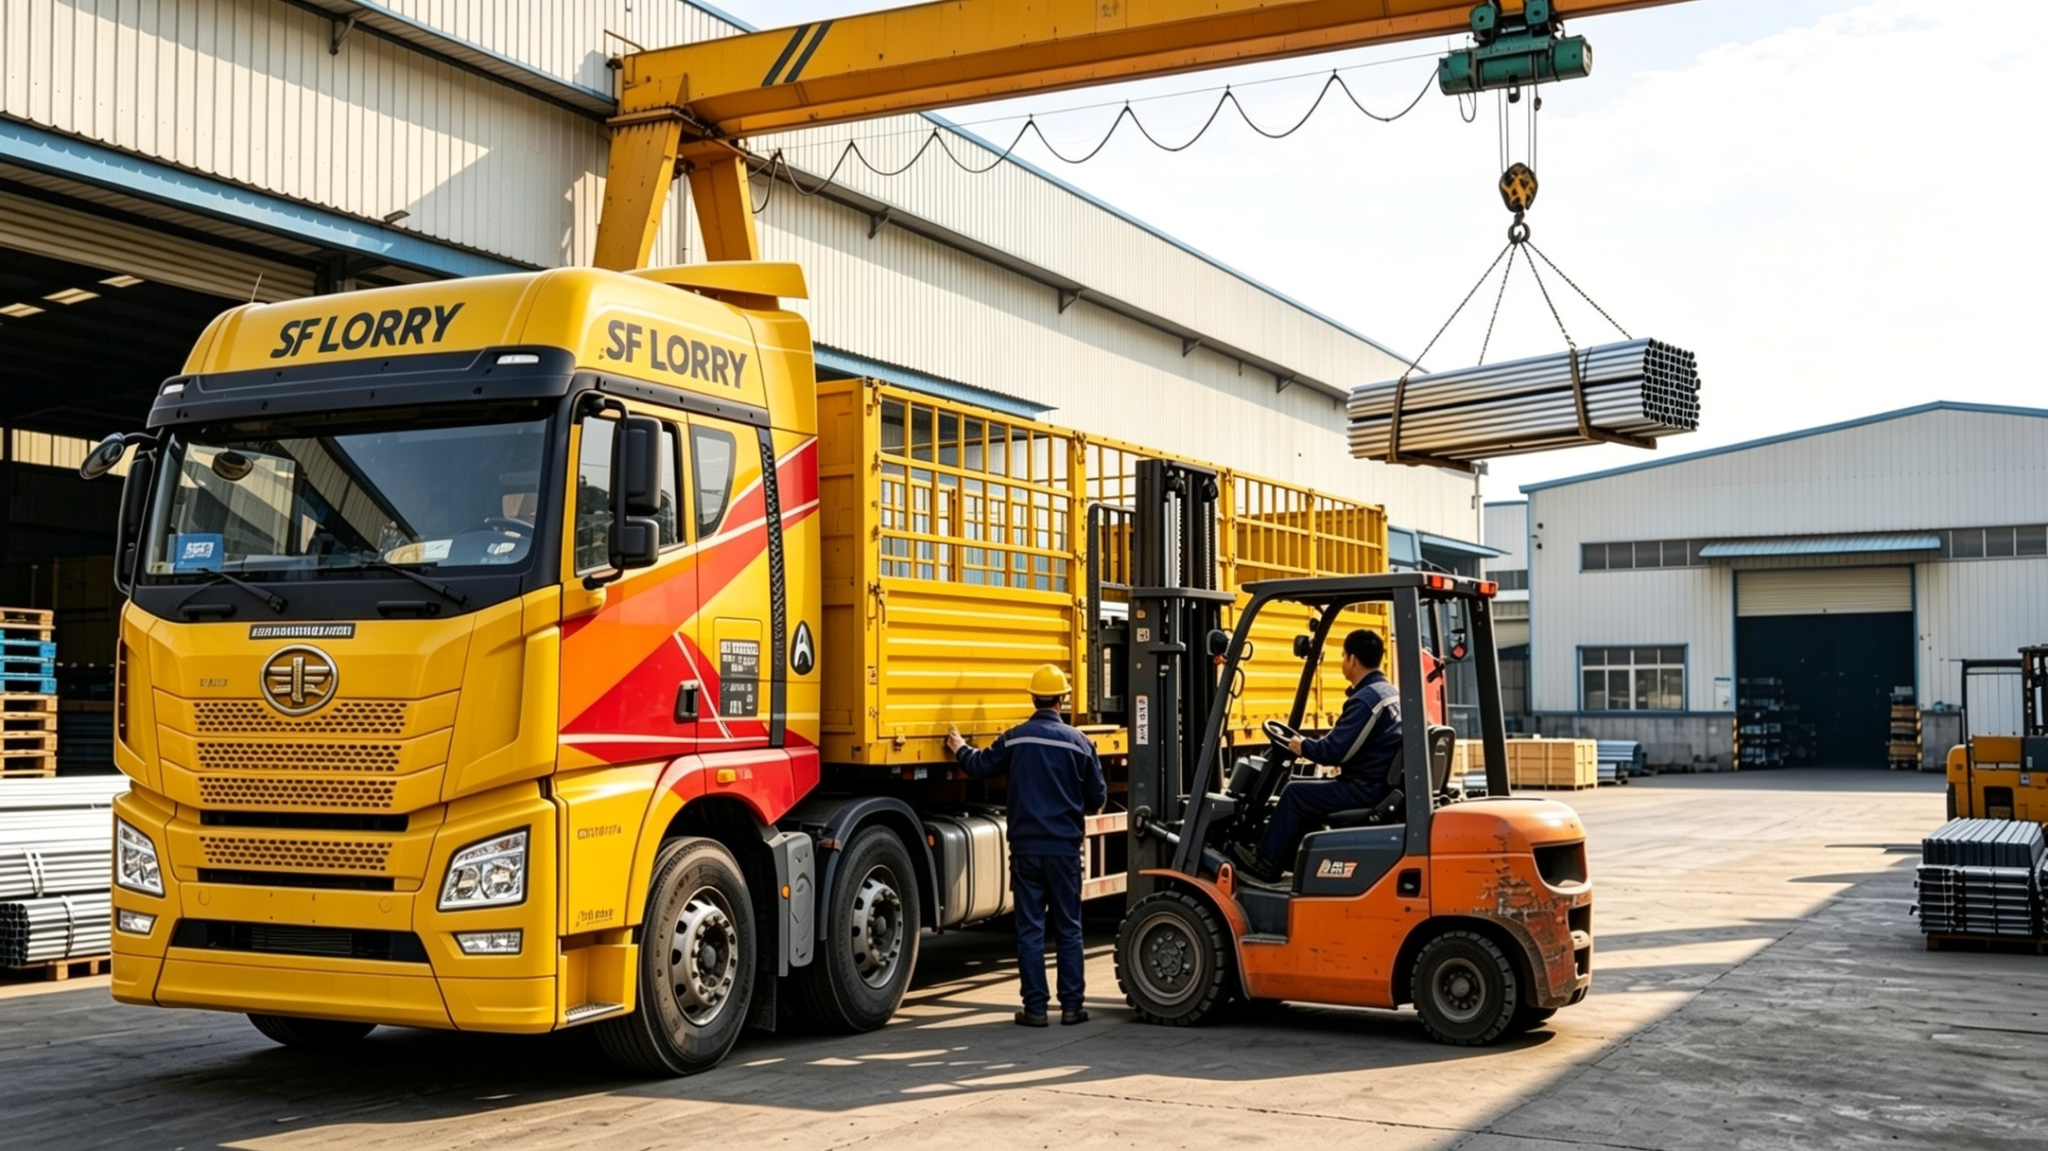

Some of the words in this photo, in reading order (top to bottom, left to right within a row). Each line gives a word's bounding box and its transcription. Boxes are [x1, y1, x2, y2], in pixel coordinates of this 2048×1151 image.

[270, 318, 322, 358] SF
[318, 302, 466, 353] LORRY
[606, 319, 643, 363] SF
[650, 329, 748, 389] LORRY
